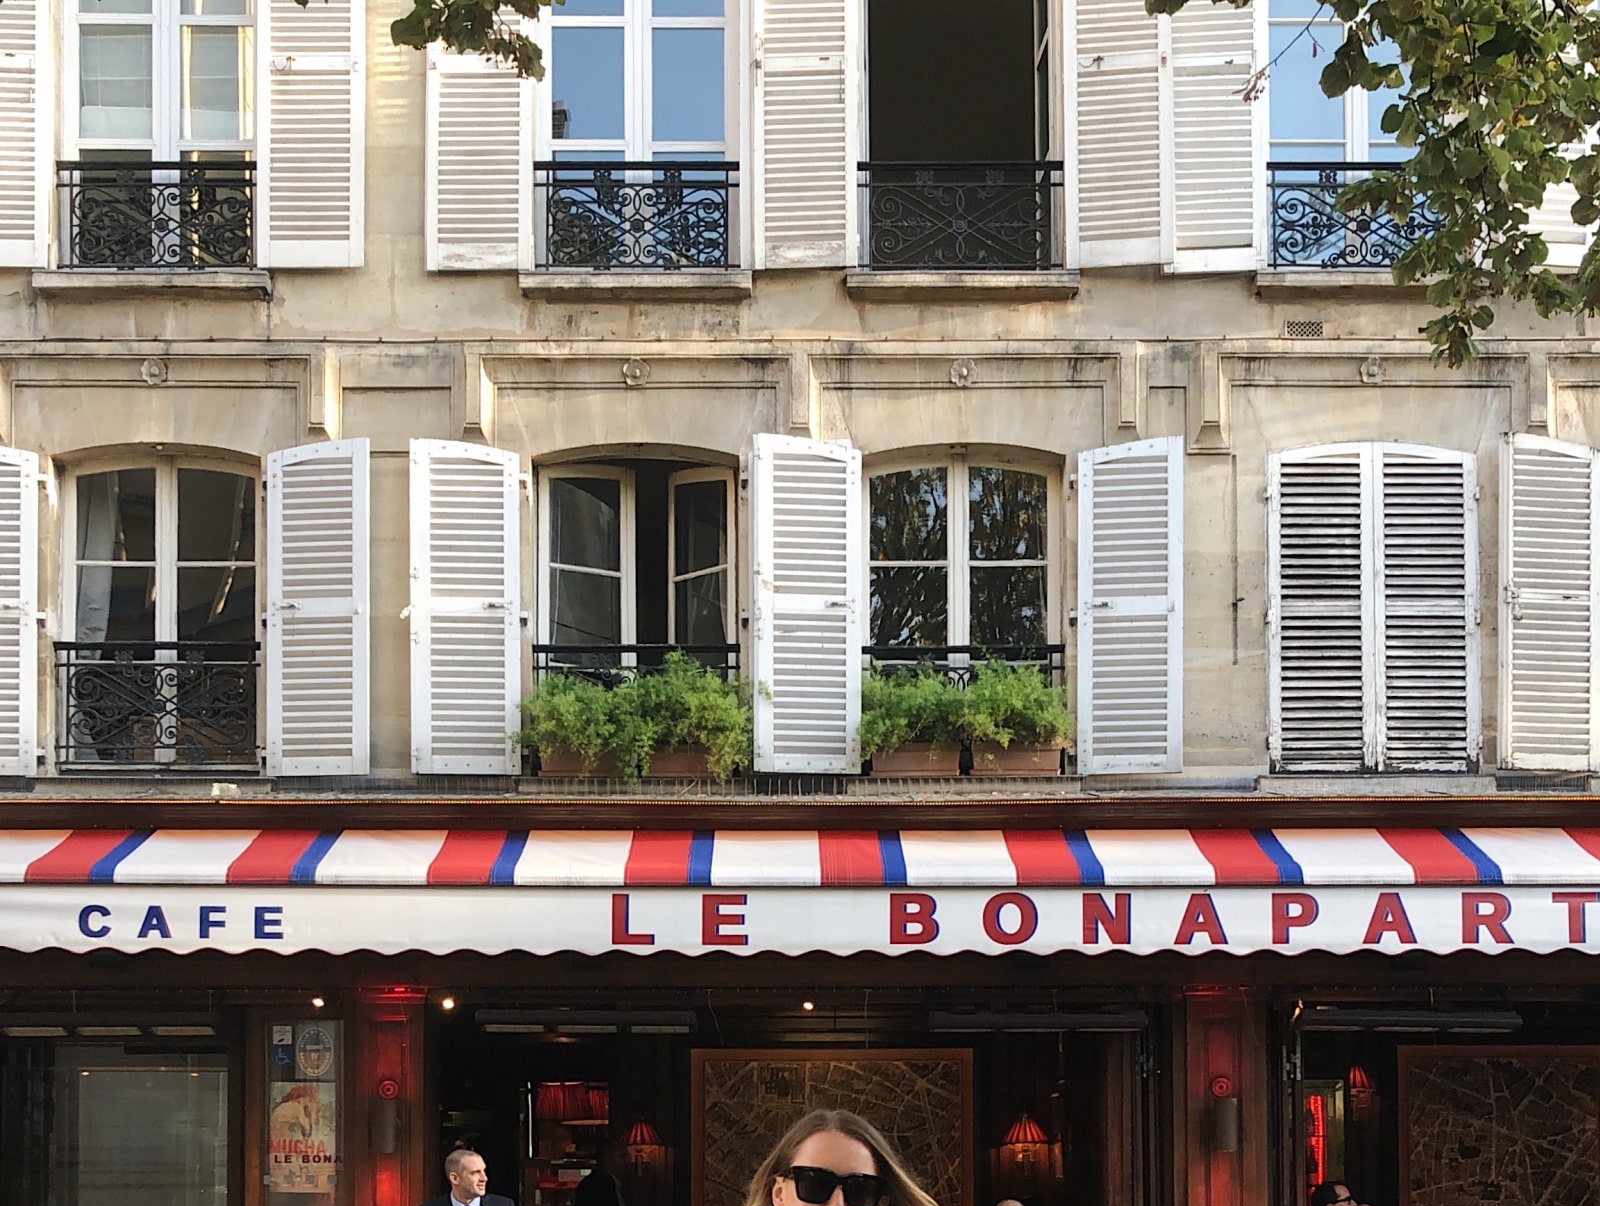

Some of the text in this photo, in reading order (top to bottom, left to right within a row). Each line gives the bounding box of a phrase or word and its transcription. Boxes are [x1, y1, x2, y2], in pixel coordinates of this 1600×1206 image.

[78, 904, 284, 940] CAFE
[611, 893, 749, 946] LE
[270, 1139, 326, 1154] MUCHA
[274, 1154, 293, 1164] LE
